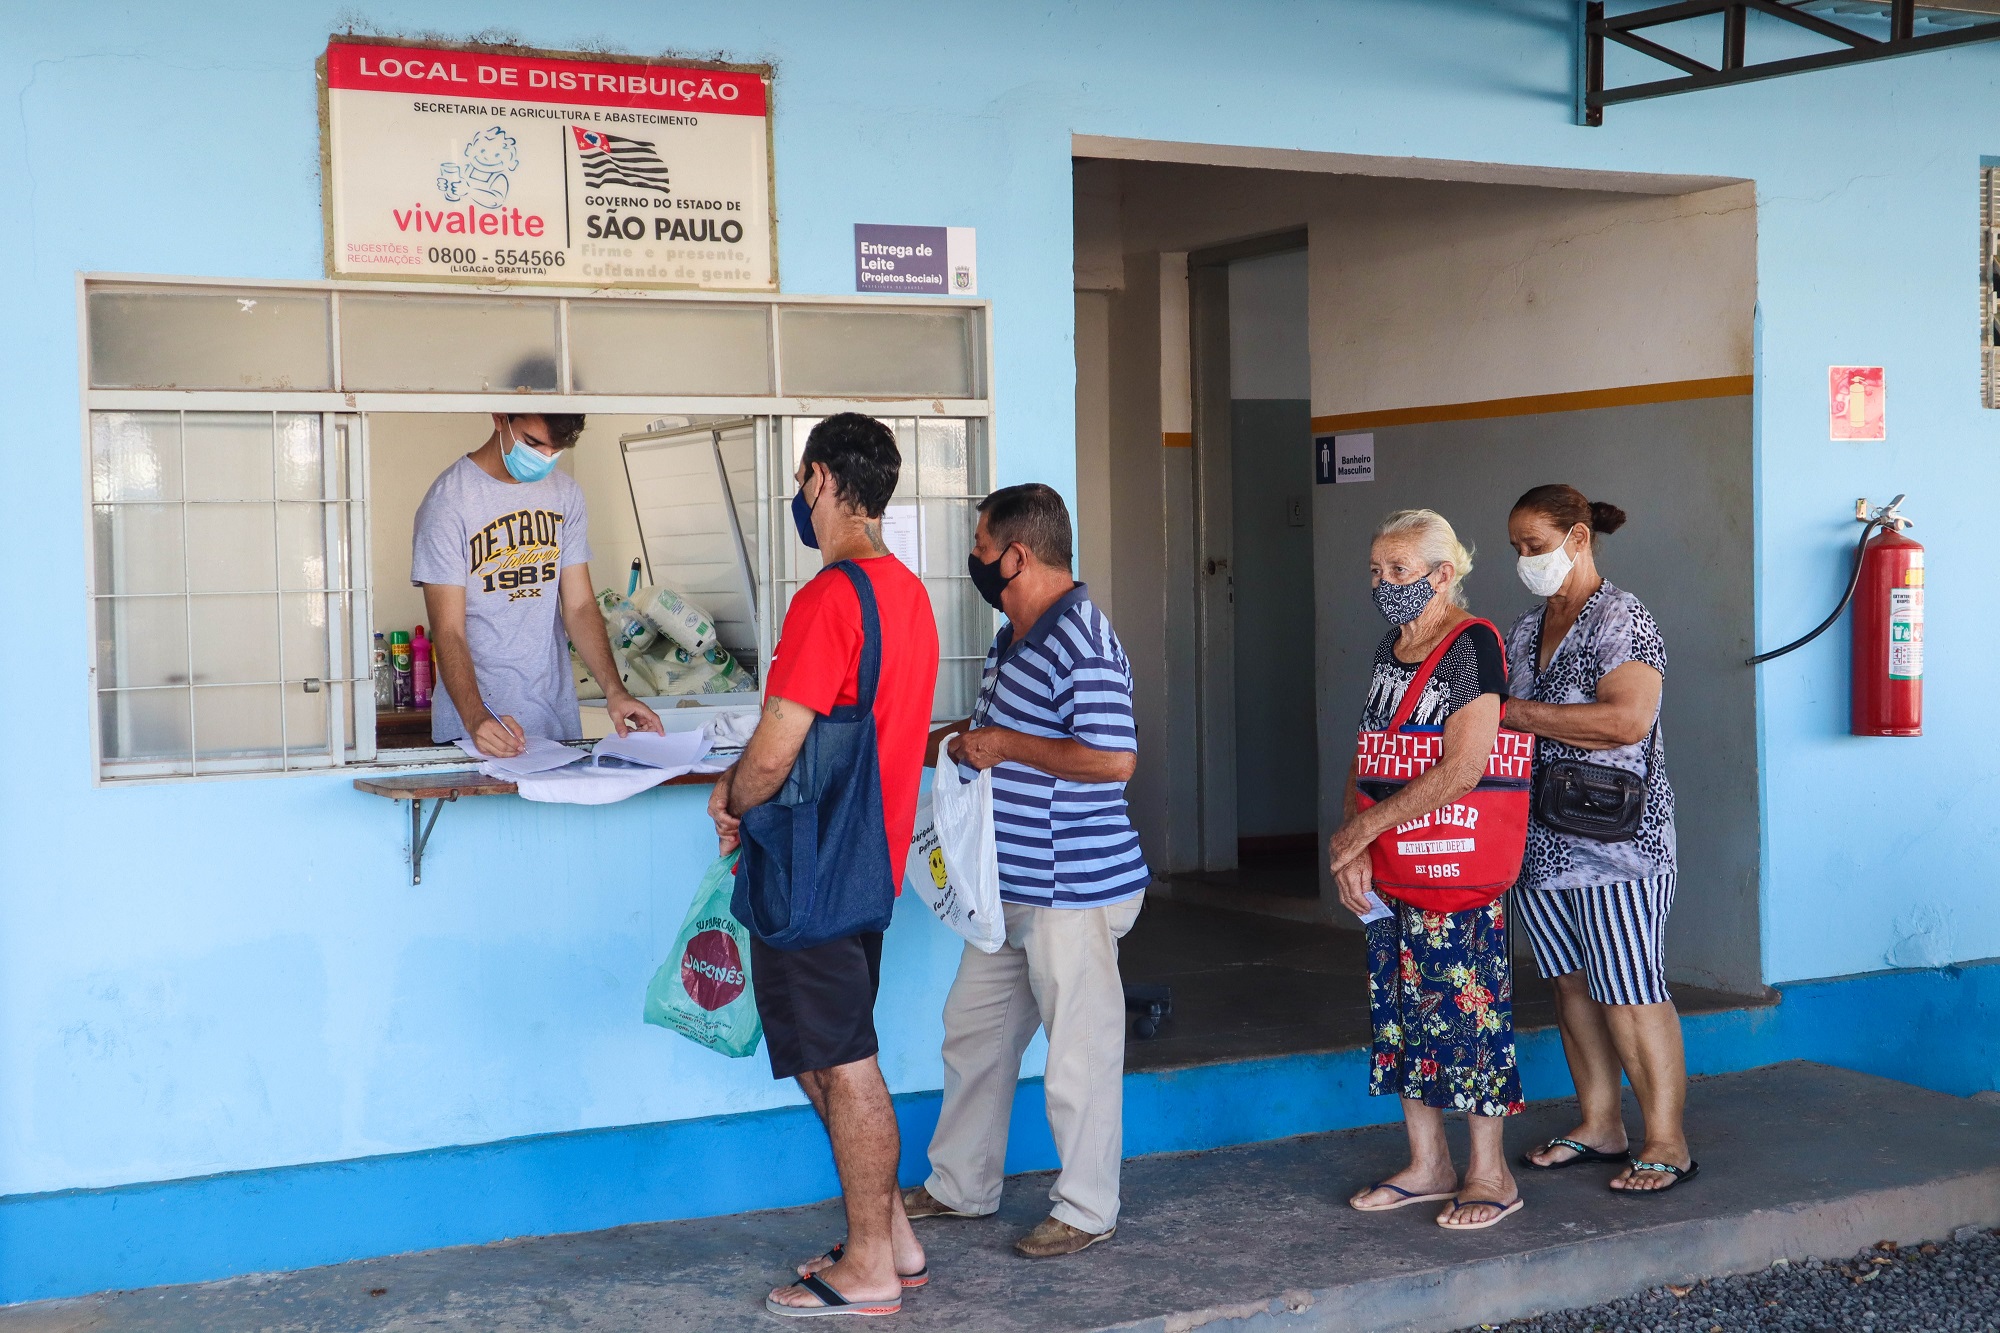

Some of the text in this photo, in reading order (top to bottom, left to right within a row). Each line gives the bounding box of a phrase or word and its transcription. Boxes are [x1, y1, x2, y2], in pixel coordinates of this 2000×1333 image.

[359, 57, 739, 102] LOCAL DE DISTRIBUIÇÃO
[413, 102, 698, 126] SECRETARIA DE AGRICULTURA E ABASTECIMENTO
[585, 196, 741, 211] GOVERNO DO ESTADO DE
[392, 202, 545, 238] vivaleite
[586, 208, 744, 244] SÃO PAULO
[347, 242, 423, 254] SUGESTÕES E
[581, 243, 752, 264] Firme e presente,
[860, 242, 933, 258] Entrega de
[347, 254, 424, 266] RECLAMAÇÕES:
[428, 247, 476, 264] 0800
[494, 249, 566, 267] 554566
[861, 256, 895, 270] Leite
[497, 266, 547, 275] GRATUITA)
[582, 263, 752, 282] Cuidando de gente
[861, 272, 943, 286] (Projetos Sociais)
[1342, 454, 1371, 464] Banheiro
[1338, 465, 1372, 476] Masculino
[482, 562, 556, 593] 1985
[1428, 863, 1460, 878] 1985
